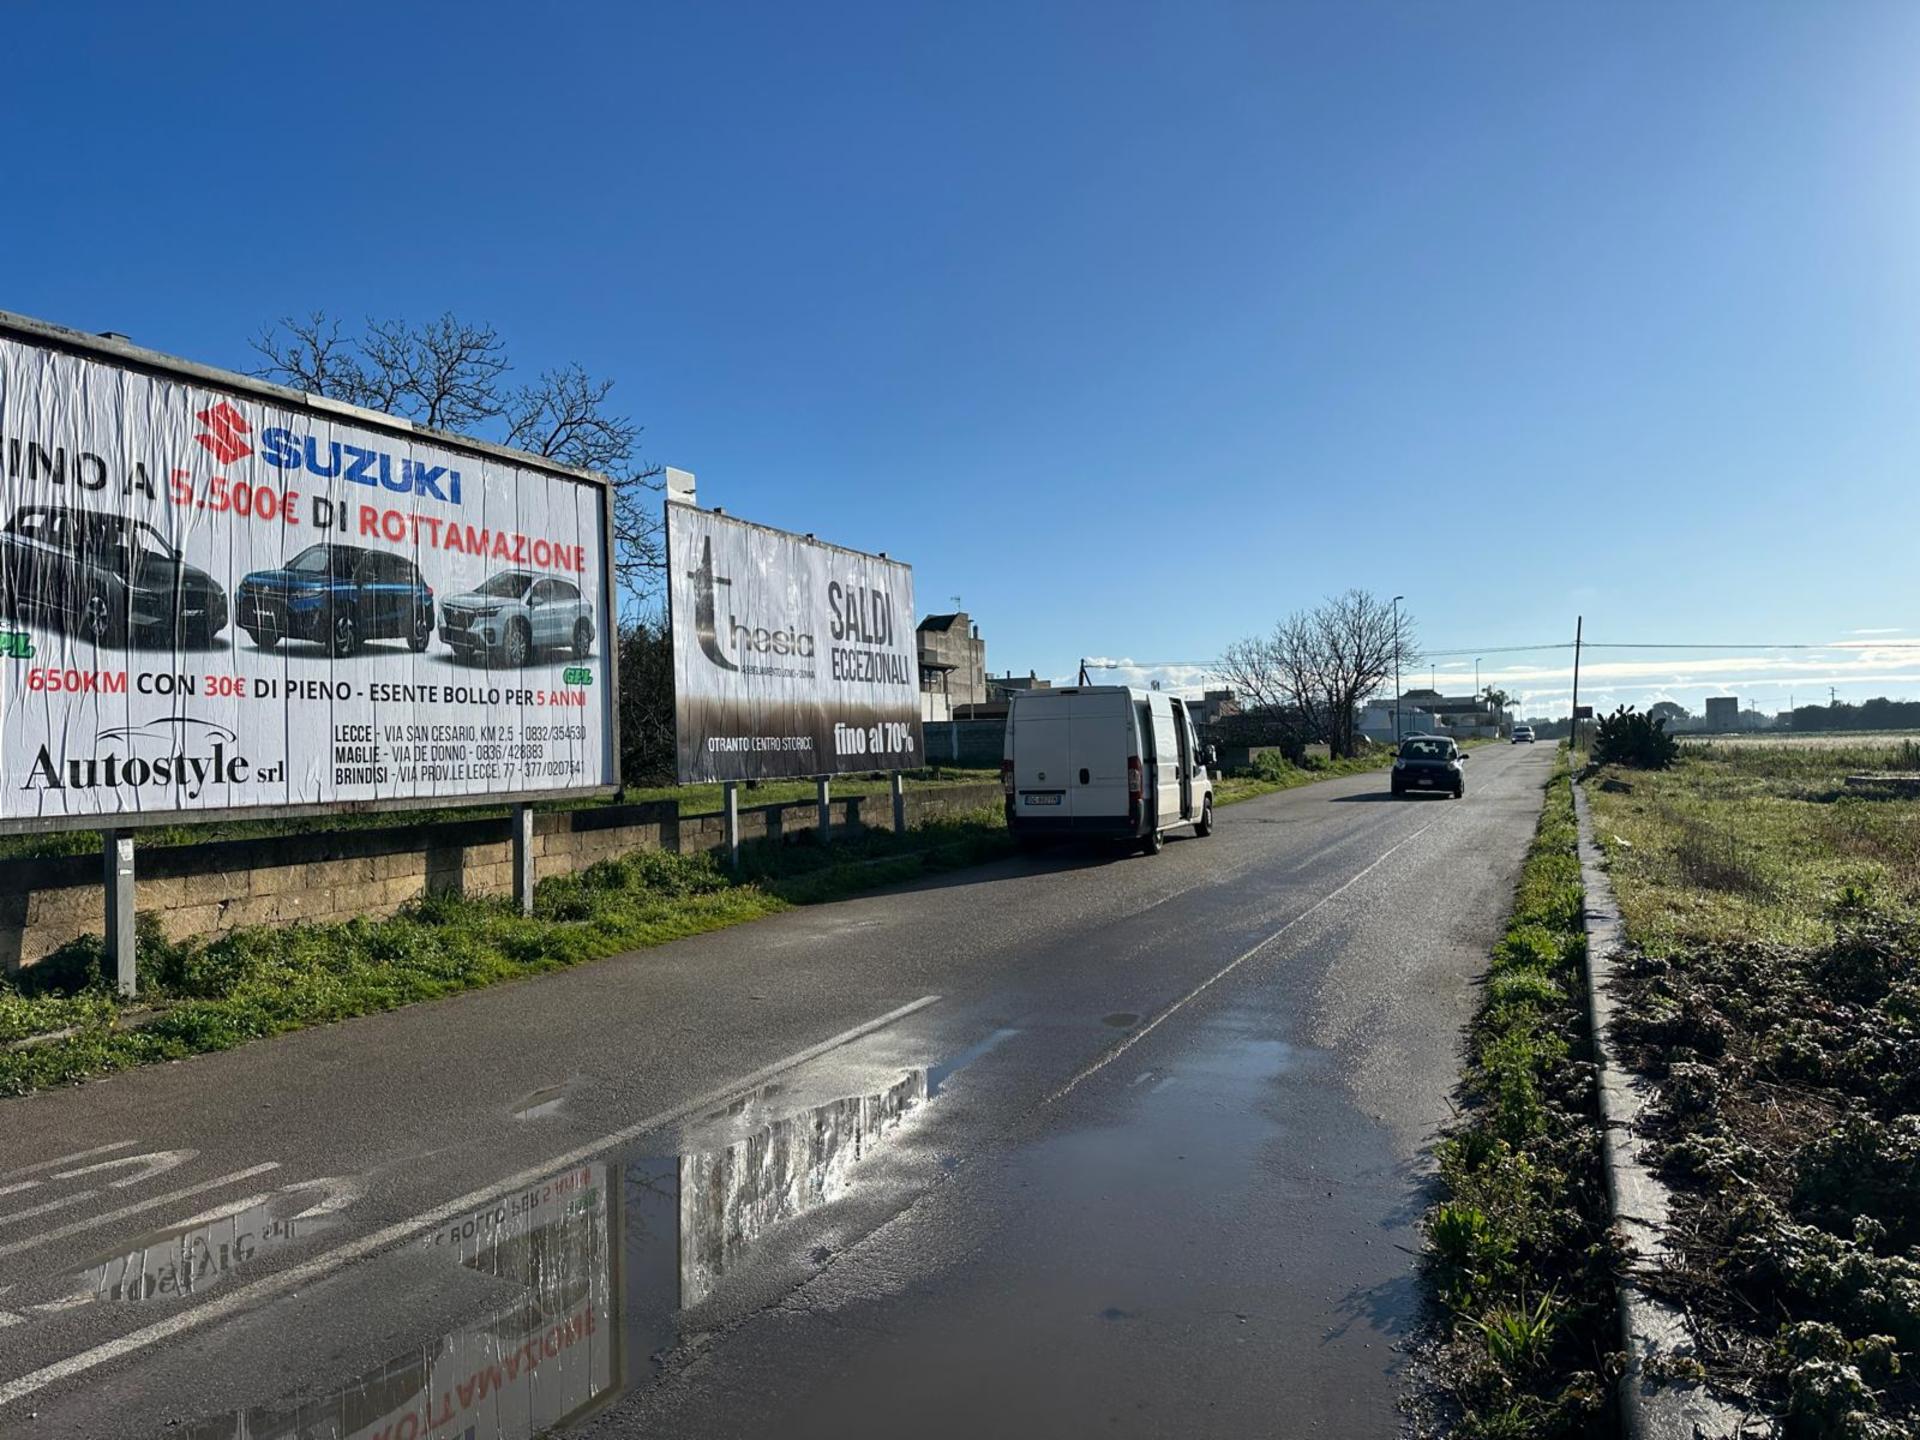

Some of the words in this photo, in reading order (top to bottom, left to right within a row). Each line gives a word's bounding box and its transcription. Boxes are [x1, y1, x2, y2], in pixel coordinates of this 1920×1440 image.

[261, 427, 461, 505] SUZUKI
[0, 435, 107, 491] INO
[123, 462, 156, 500] A
[169, 468, 300, 525] 5.500€
[312, 495, 347, 532] DI
[359, 505, 586, 573] ROTTAMAZIONE
[828, 580, 894, 647] SALDI
[0, 631, 36, 659] PL
[562, 667, 593, 686] GPL
[831, 647, 911, 685] ECCEZIONALI
[27, 668, 127, 694] 650KM
[137, 672, 195, 696] CON
[204, 675, 247, 698] 30€
[254, 678, 277, 699] DI
[286, 679, 351, 701] PIENO
[370, 683, 438, 703] ESENTE
[443, 687, 500, 706] BOLLO
[506, 689, 534, 706] PER
[537, 691, 545, 706] 5
[549, 691, 586, 707] ANNI
[335, 725, 372, 742] LECCE
[384, 725, 404, 742] VIA
[406, 725, 429, 742] SAN
[480, 726, 496, 742] KM
[525, 726, 587, 741] 0832/354530
[708, 736, 750, 752] OTRANTO
[751, 736, 781, 752] CENTRO
[834, 722, 866, 755] fino
[868, 722, 884, 754] al
[885, 722, 914, 753] 70%
[335, 746, 380, 763] MAGLIE
[392, 746, 411, 762] VIA
[414, 745, 428, 761] DE
[431, 745, 466, 761] DONNO
[20, 743, 250, 799] Autostyle
[257, 760, 285, 783] srl
[335, 766, 388, 785] BRINDISI
[399, 766, 418, 782] VIA
[421, 764, 465, 781] PROV.LE
[503, 763, 515, 779] 77
